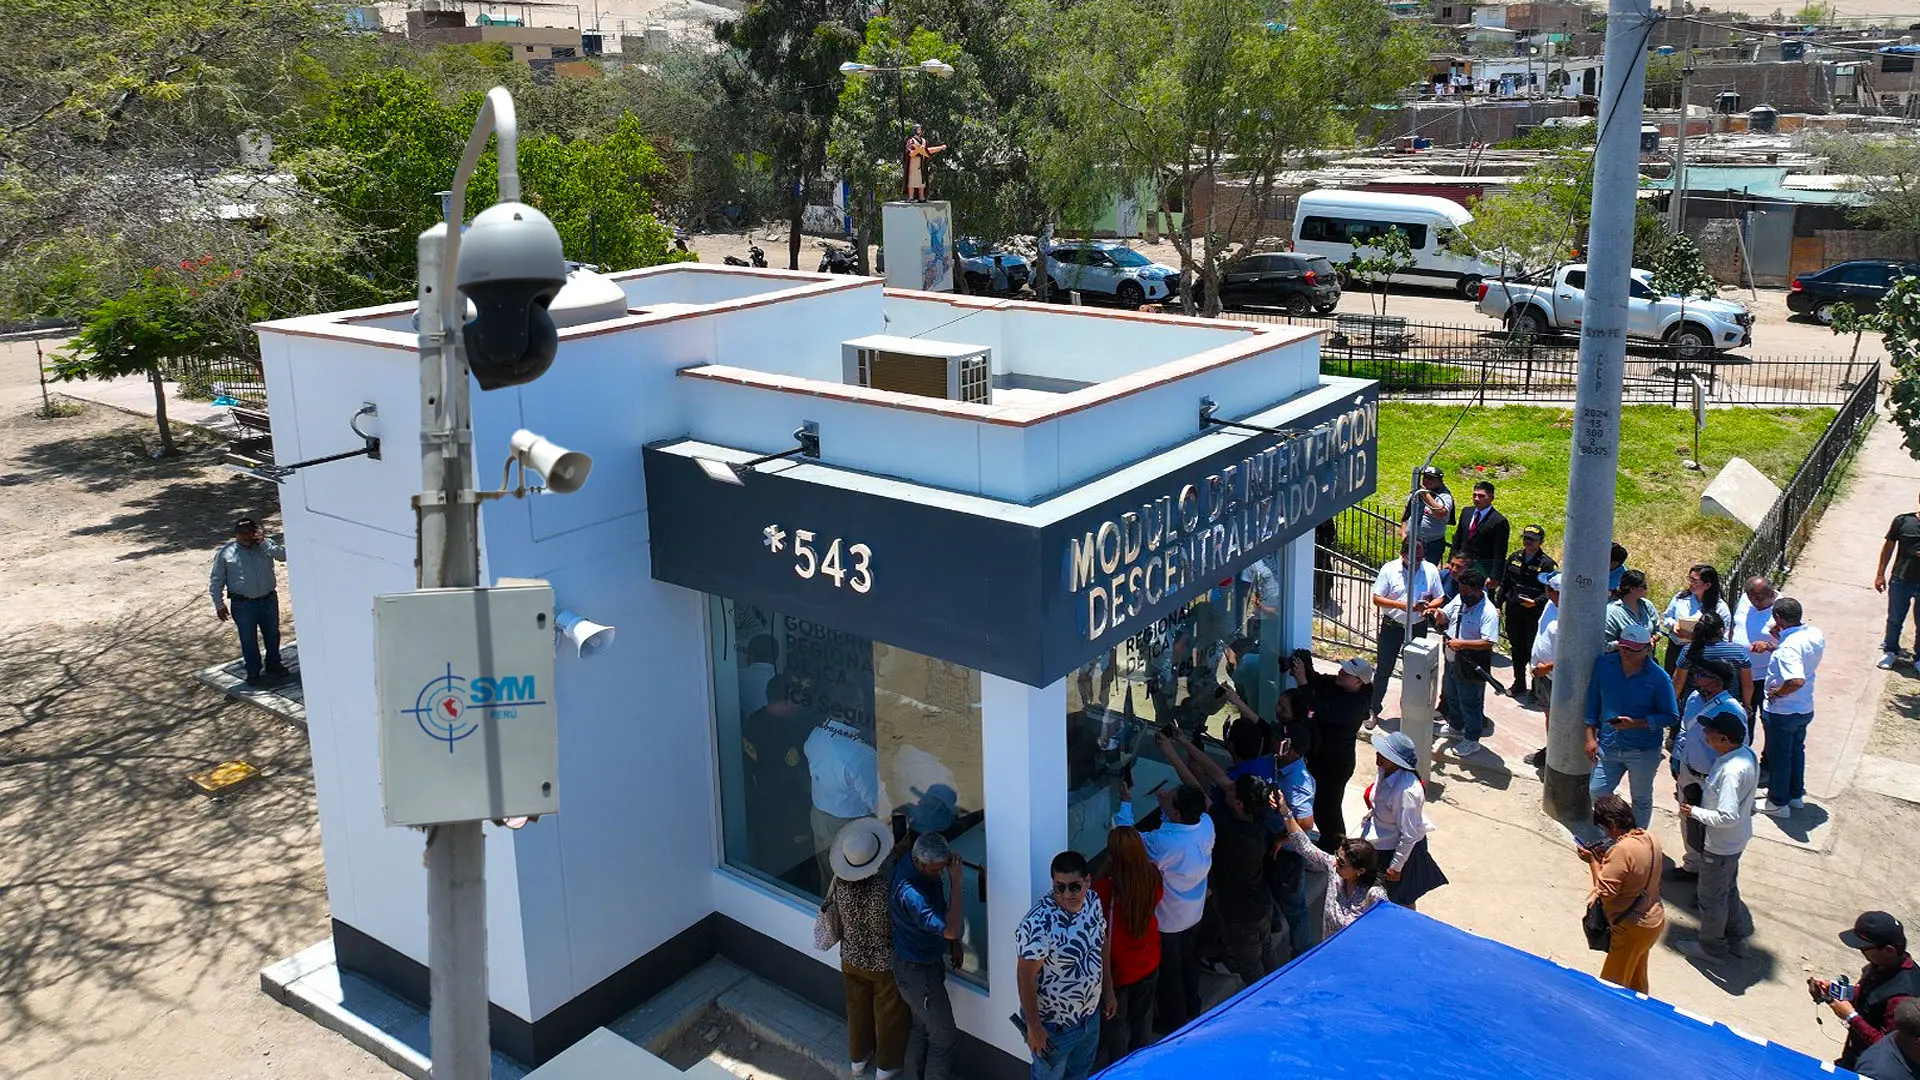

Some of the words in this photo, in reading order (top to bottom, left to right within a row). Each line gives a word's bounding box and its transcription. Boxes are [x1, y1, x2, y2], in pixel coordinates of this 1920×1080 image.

[1584, 408, 1608, 418] 2024
[1585, 428, 1603, 438] 300
[1590, 437, 1596, 446] 2
[1069, 484, 1199, 593] MODULO
[1205, 464, 1238, 523] DE
[1089, 475, 1317, 640] DESCENTRALIZADO
[470, 675, 536, 703] SYM
[490, 709, 518, 720] PERÚ
